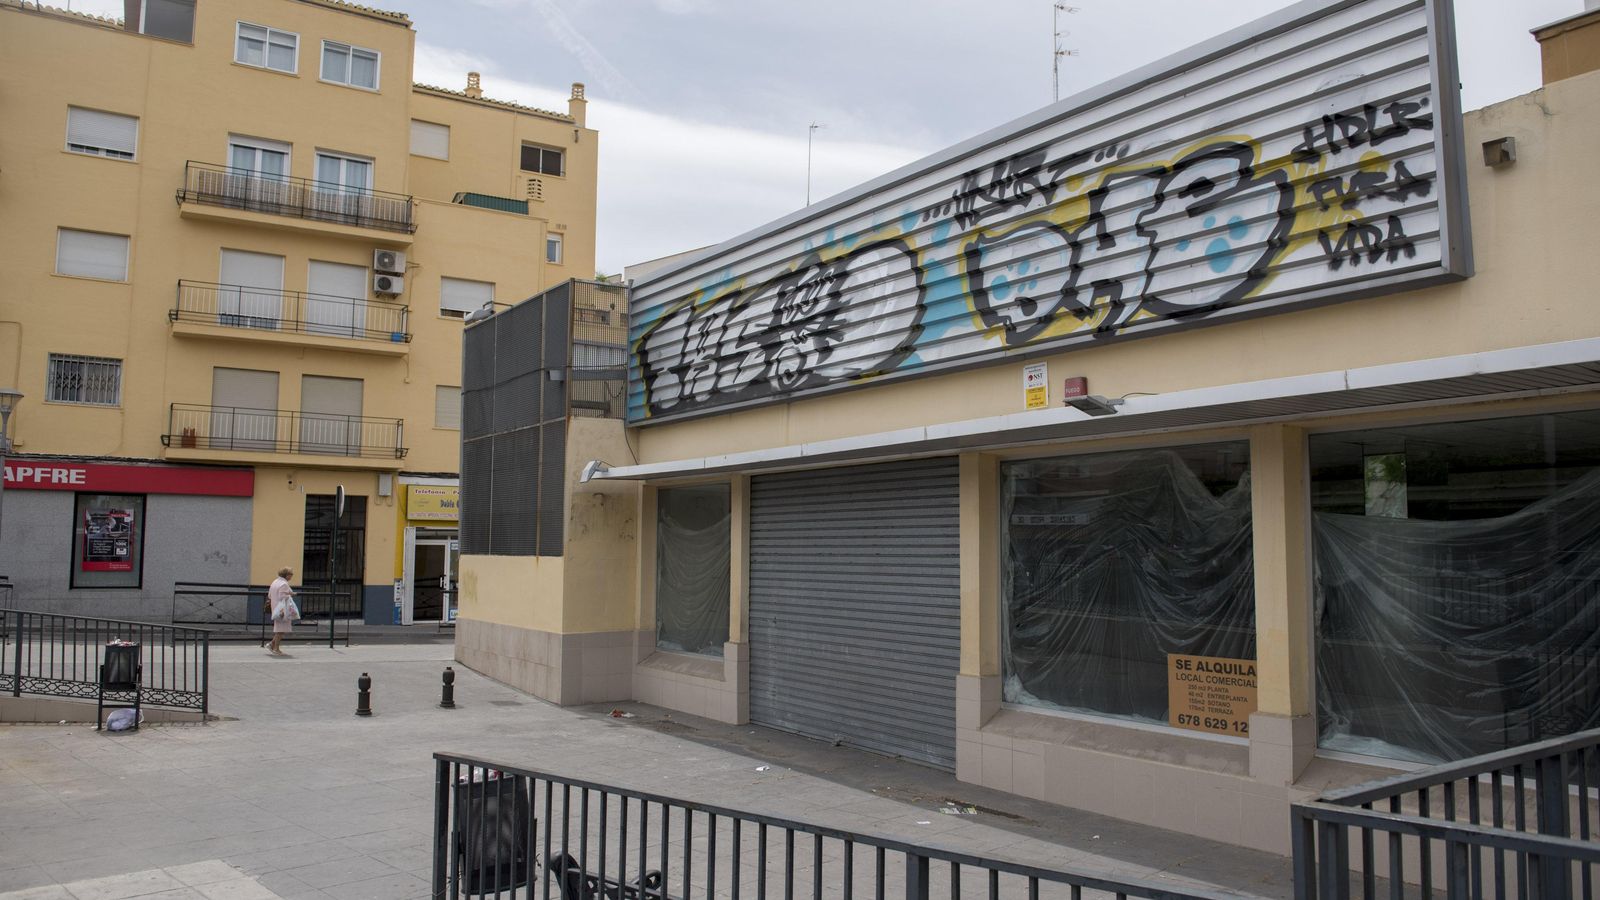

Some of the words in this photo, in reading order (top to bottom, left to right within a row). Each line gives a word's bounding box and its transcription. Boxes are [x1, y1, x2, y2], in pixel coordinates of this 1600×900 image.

[1175, 659, 1192, 670] SE
[1196, 661, 1257, 677] ALQUILA
[1175, 672, 1204, 683] LOCAL
[1205, 675, 1258, 688] COMERCIAL
[1207, 686, 1230, 694] PLANTA
[1207, 693, 1249, 703] ENTREPLANTA
[1208, 706, 1233, 715] TERRAZA
[1178, 713, 1200, 727] 678
[1204, 717, 1228, 730] 629
